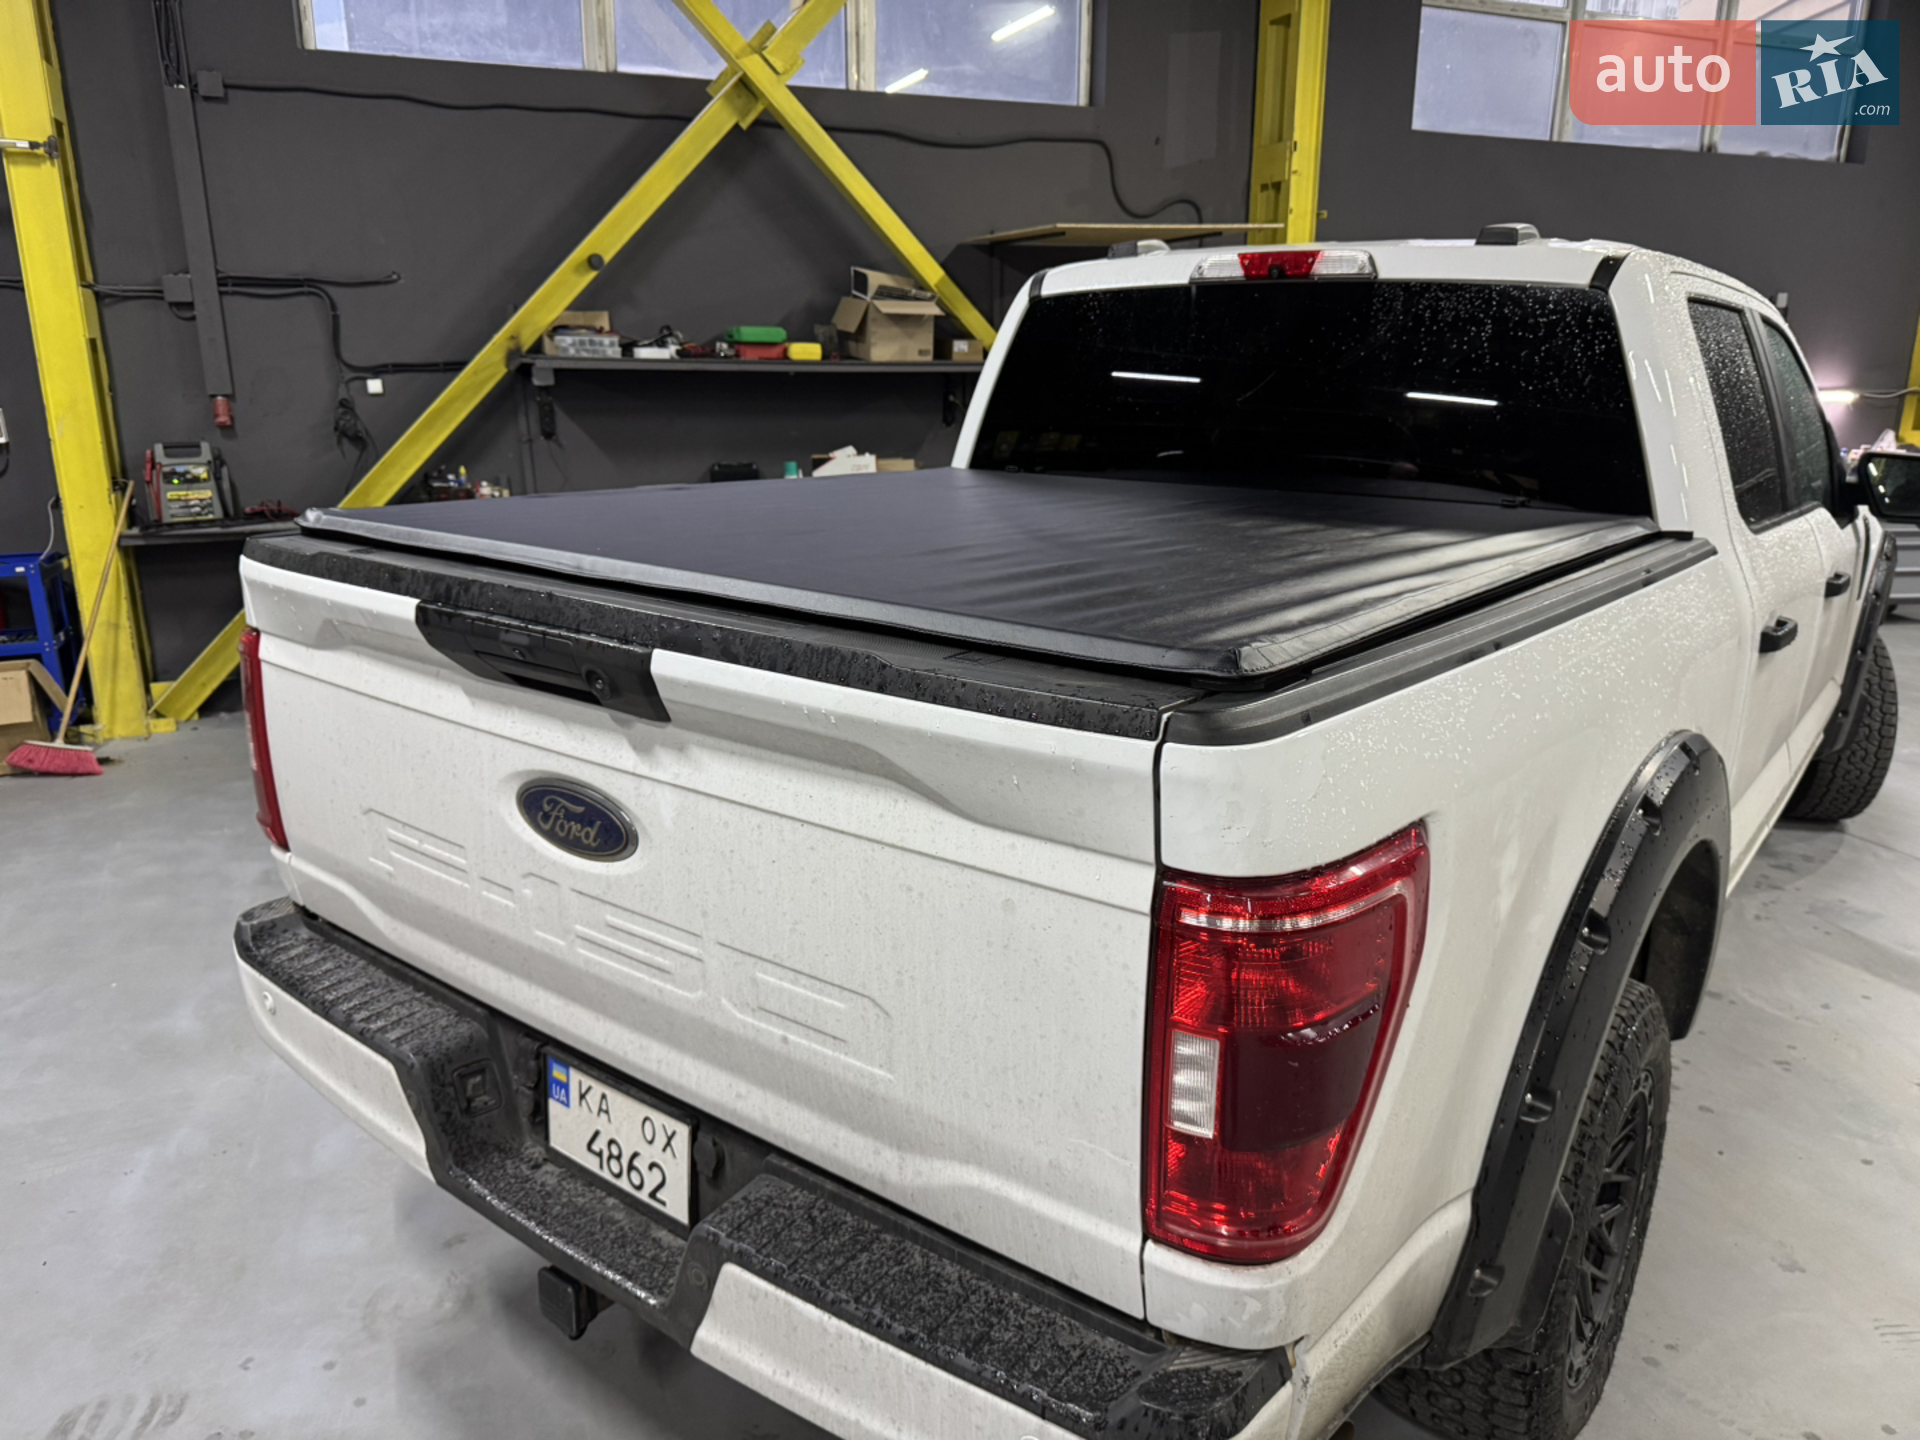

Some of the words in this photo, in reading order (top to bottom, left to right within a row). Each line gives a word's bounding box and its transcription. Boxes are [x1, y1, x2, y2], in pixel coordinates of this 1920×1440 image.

[537, 795, 603, 848] Ford
[551, 1083, 569, 1104] UA
[578, 1079, 612, 1124] KA
[641, 1115, 678, 1160] OX
[586, 1128, 667, 1207] 4862
